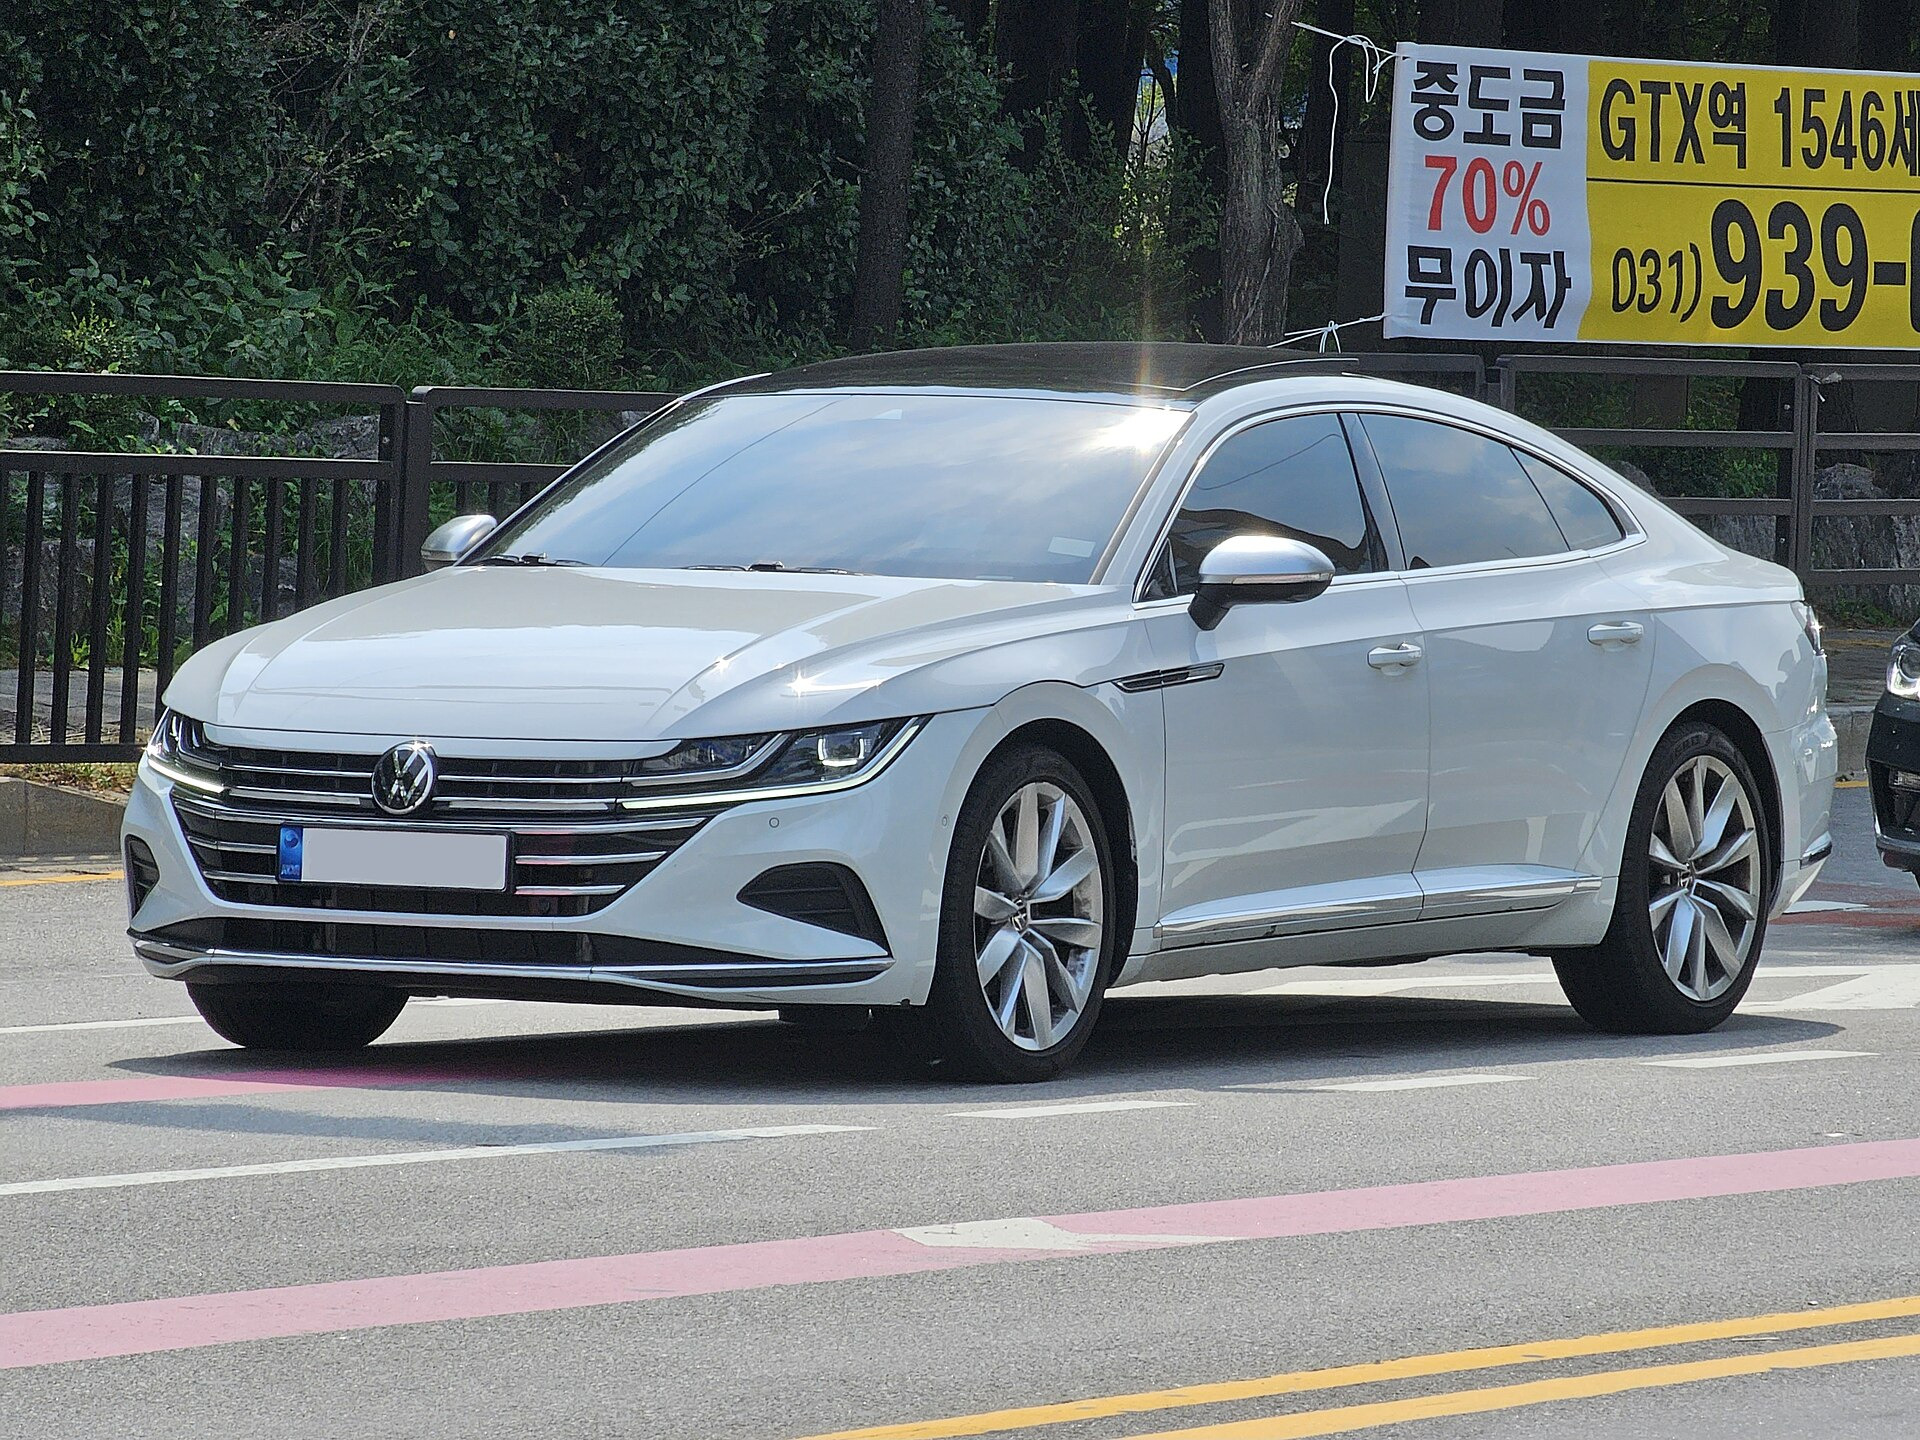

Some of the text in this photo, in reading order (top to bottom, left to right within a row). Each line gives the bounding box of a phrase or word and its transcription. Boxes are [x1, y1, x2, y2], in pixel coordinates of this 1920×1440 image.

[1410, 60, 1566, 150] 중도금
[1599, 78, 1748, 170] GTX역
[1425, 156, 1551, 236] 70%
[1404, 244, 1573, 329] 무이자
